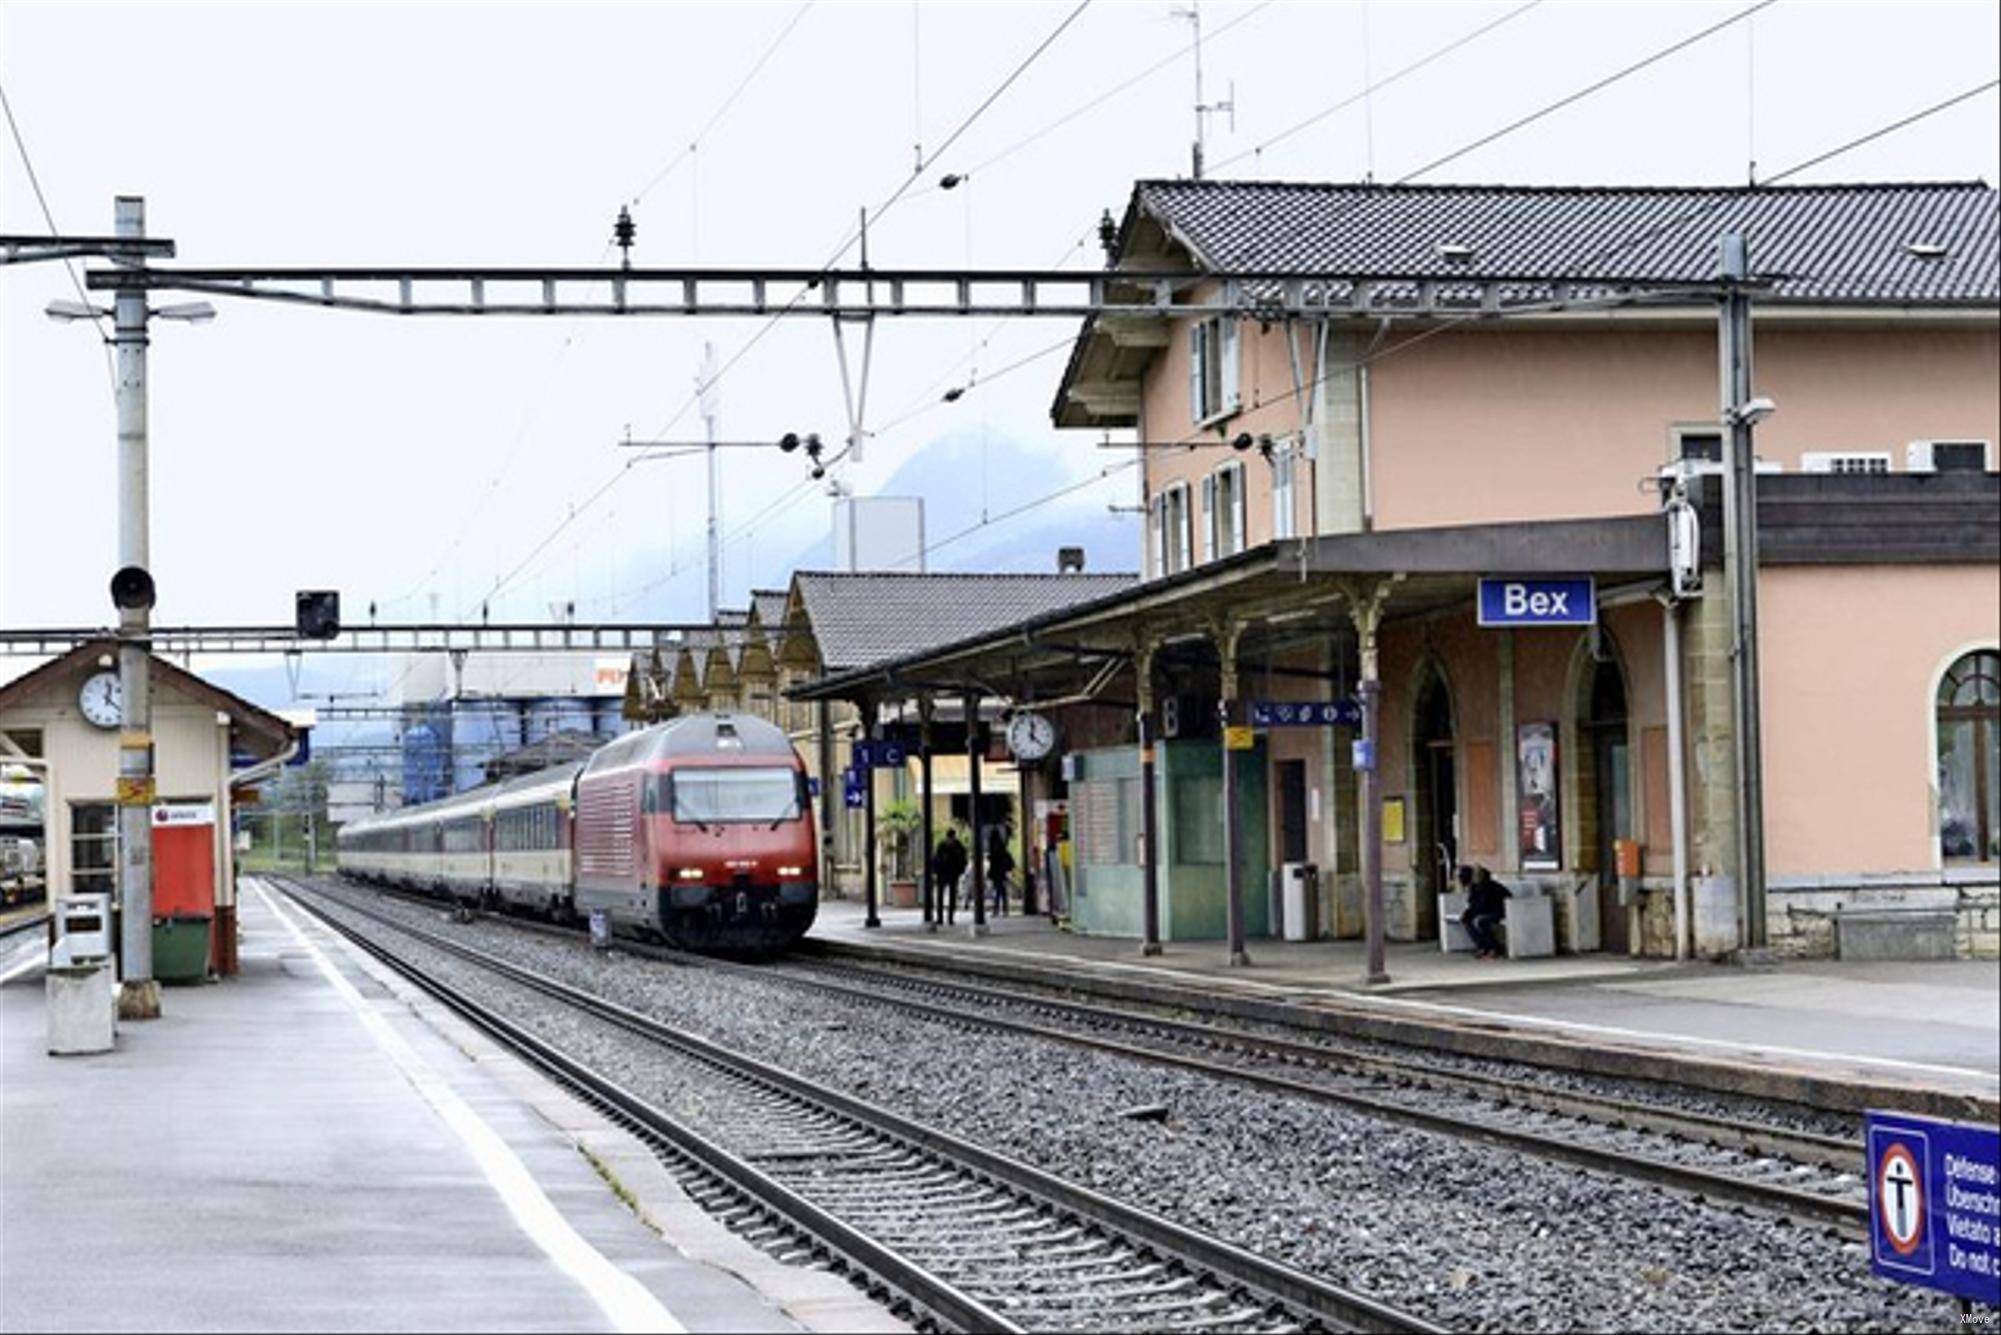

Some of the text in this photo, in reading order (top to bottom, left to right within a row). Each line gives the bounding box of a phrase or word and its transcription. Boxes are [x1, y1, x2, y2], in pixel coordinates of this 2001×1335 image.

[1504, 582, 1569, 616] Bex
[1946, 1212, 1993, 1245] Vietato
[1948, 1243, 1966, 1271] Do
[1968, 1249, 1992, 1277] not
